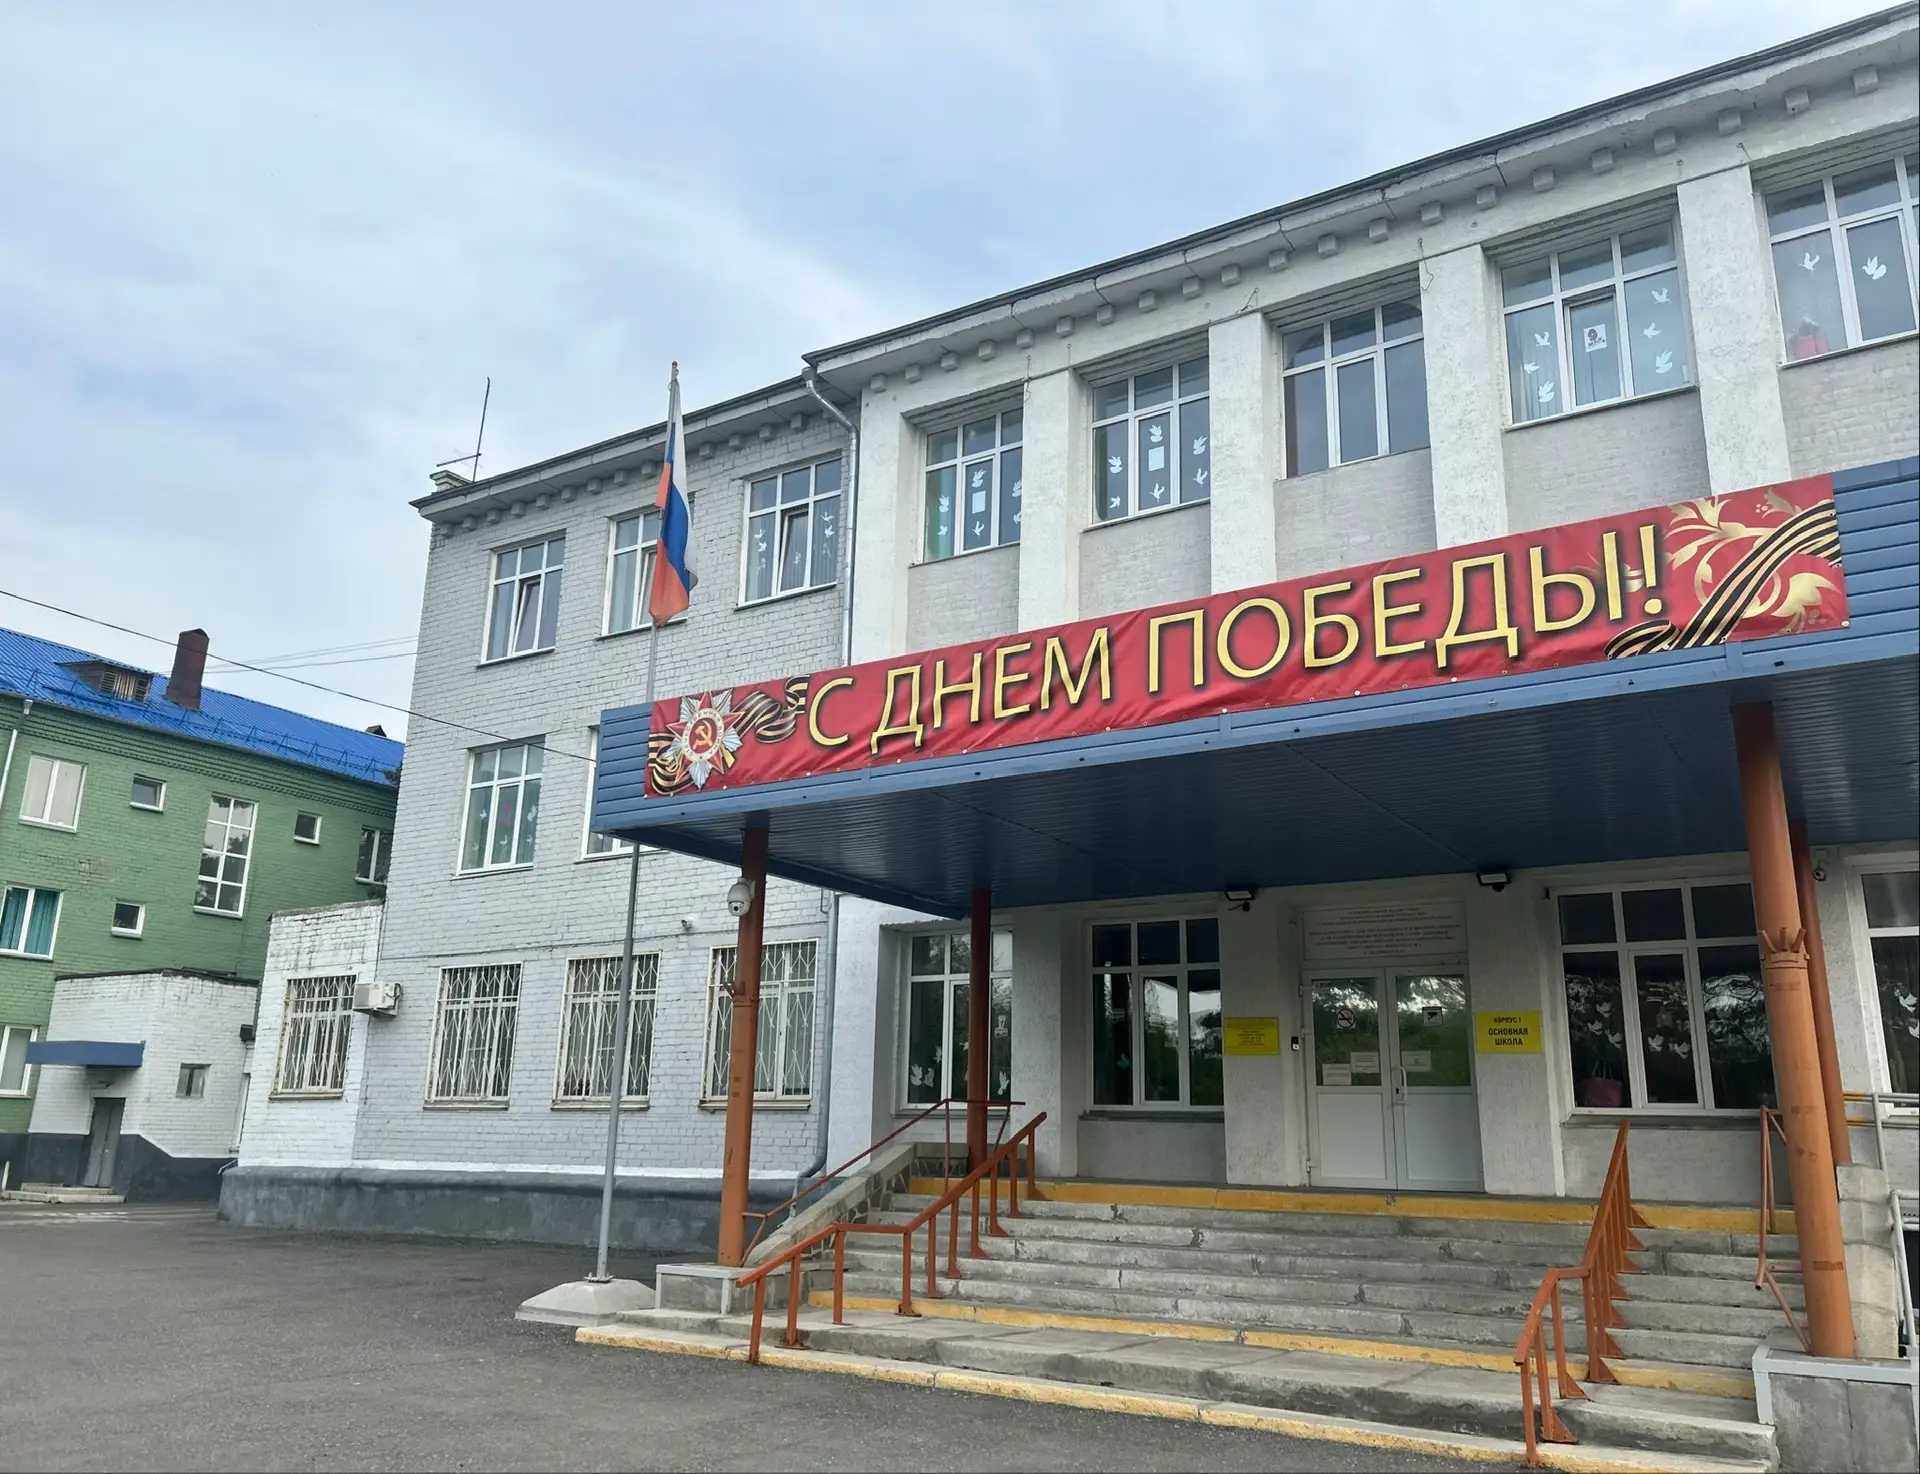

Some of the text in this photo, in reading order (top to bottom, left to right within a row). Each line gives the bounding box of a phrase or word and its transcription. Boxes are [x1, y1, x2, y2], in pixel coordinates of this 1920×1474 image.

[1588, 328, 1597, 341] 9
[809, 524, 1663, 755] С ДНЕМ ПОБЕДЫ!
[1493, 1016, 1517, 1024] КОРПУС
[1488, 1027, 1529, 1036] ОСНОВНАЯ
[1495, 1037, 1524, 1046] ШКОЛА
